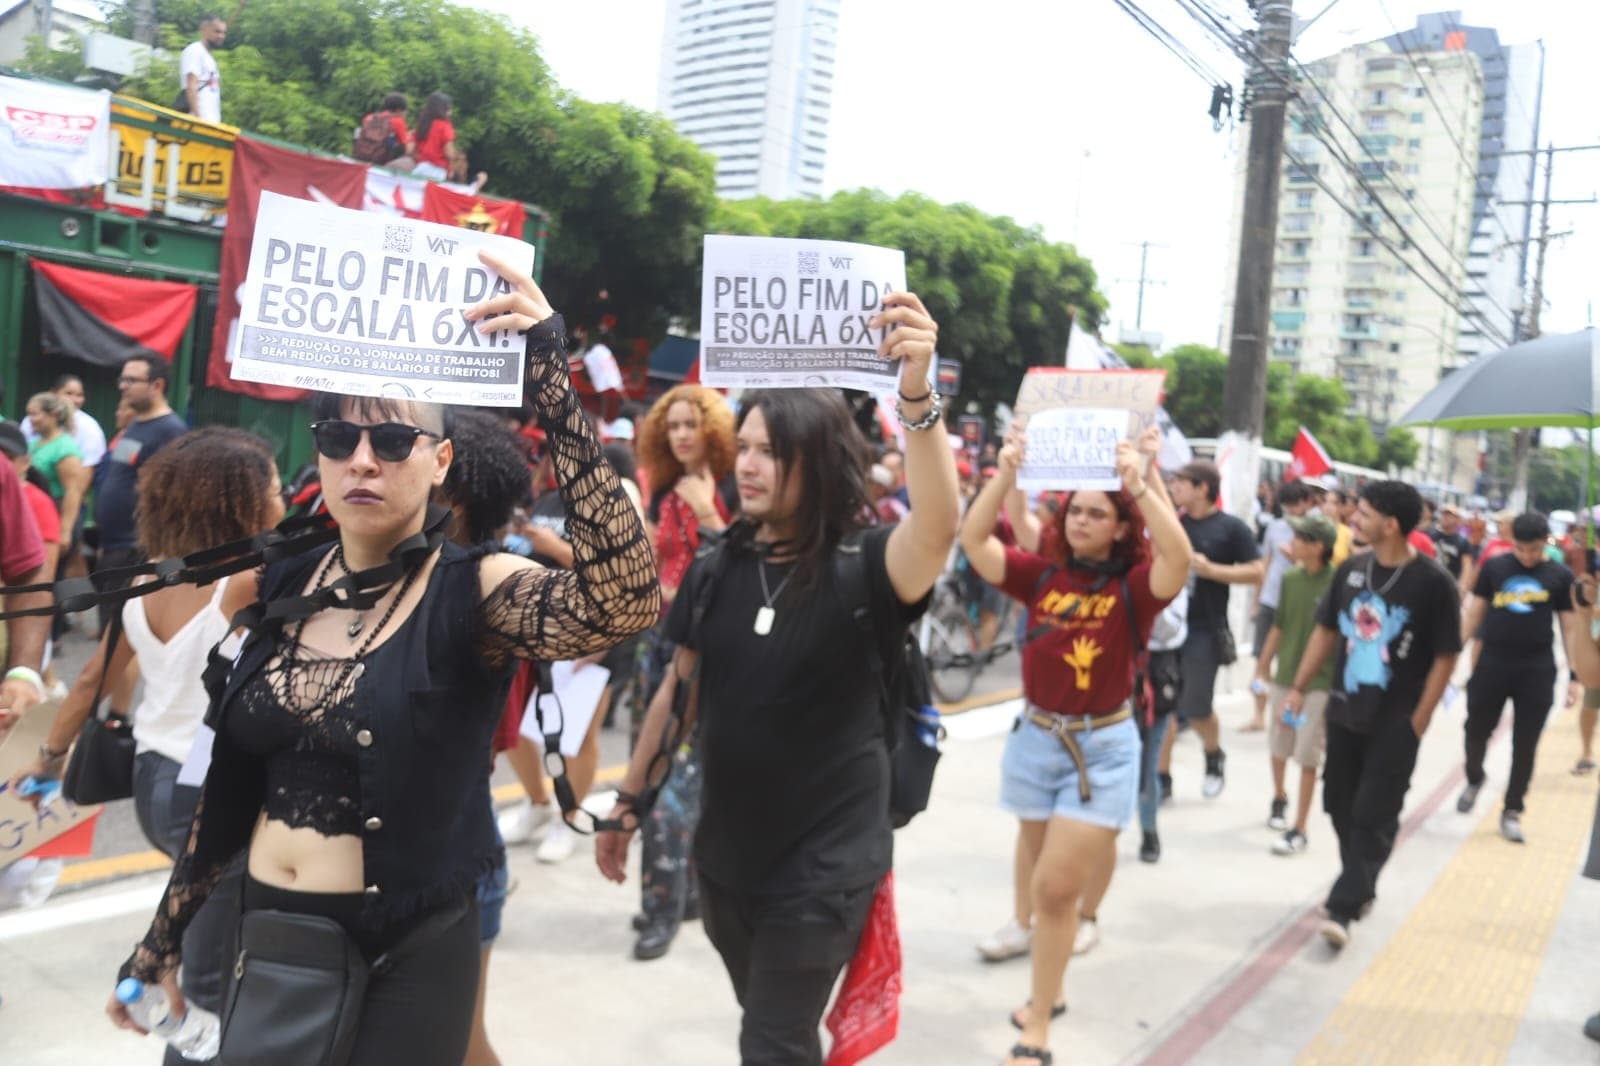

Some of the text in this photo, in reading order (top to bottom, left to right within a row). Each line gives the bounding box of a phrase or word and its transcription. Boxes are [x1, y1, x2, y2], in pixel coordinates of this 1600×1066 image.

[426, 235, 459, 256] VAT
[263, 238, 511, 304] PELO FIM DA
[713, 276, 787, 310] PELO
[798, 278, 849, 311] FIM
[256, 284, 417, 344] ESCALA
[713, 312, 827, 345] ESCALA
[261, 346, 500, 378] SEM REDUÇÃO DE SALÁRIOS E DIREITOS!
[281, 337, 506, 367] REDUÇÃO DA JORNADA DE TRABALHO
